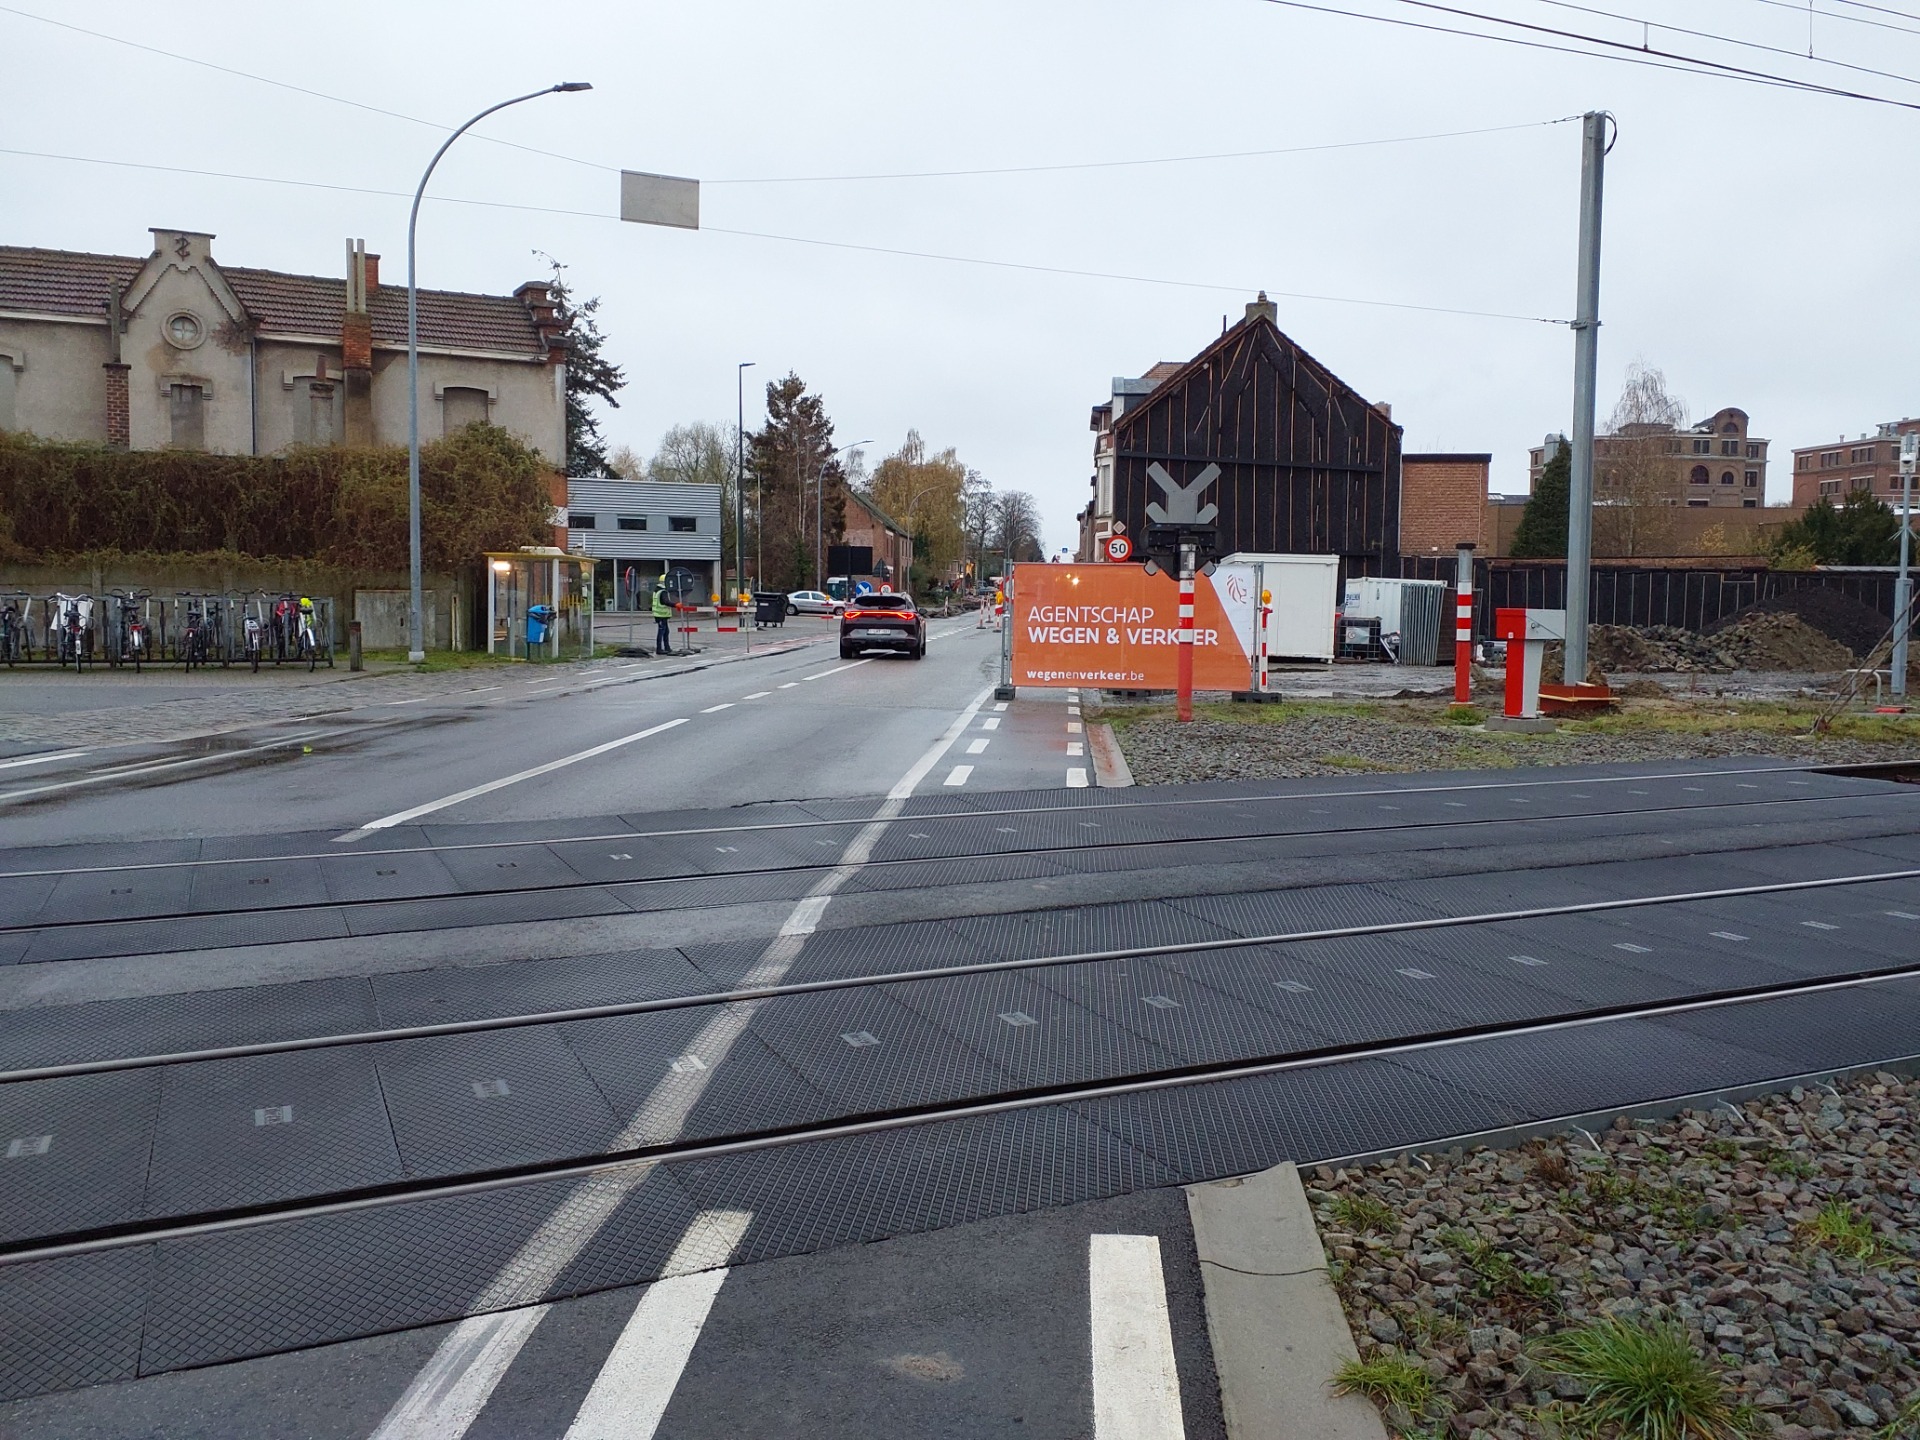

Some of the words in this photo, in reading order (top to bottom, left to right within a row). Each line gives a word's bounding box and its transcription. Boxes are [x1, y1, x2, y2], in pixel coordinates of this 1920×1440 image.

[1111, 543, 1127, 554] 50
[1027, 605, 1155, 624] AGENTSCHAP
[1027, 626, 1100, 645] WEGEN
[1106, 627, 1120, 645] &
[1126, 628, 1219, 646] VERKER
[1026, 670, 1145, 682] wegenenverkeer.be
